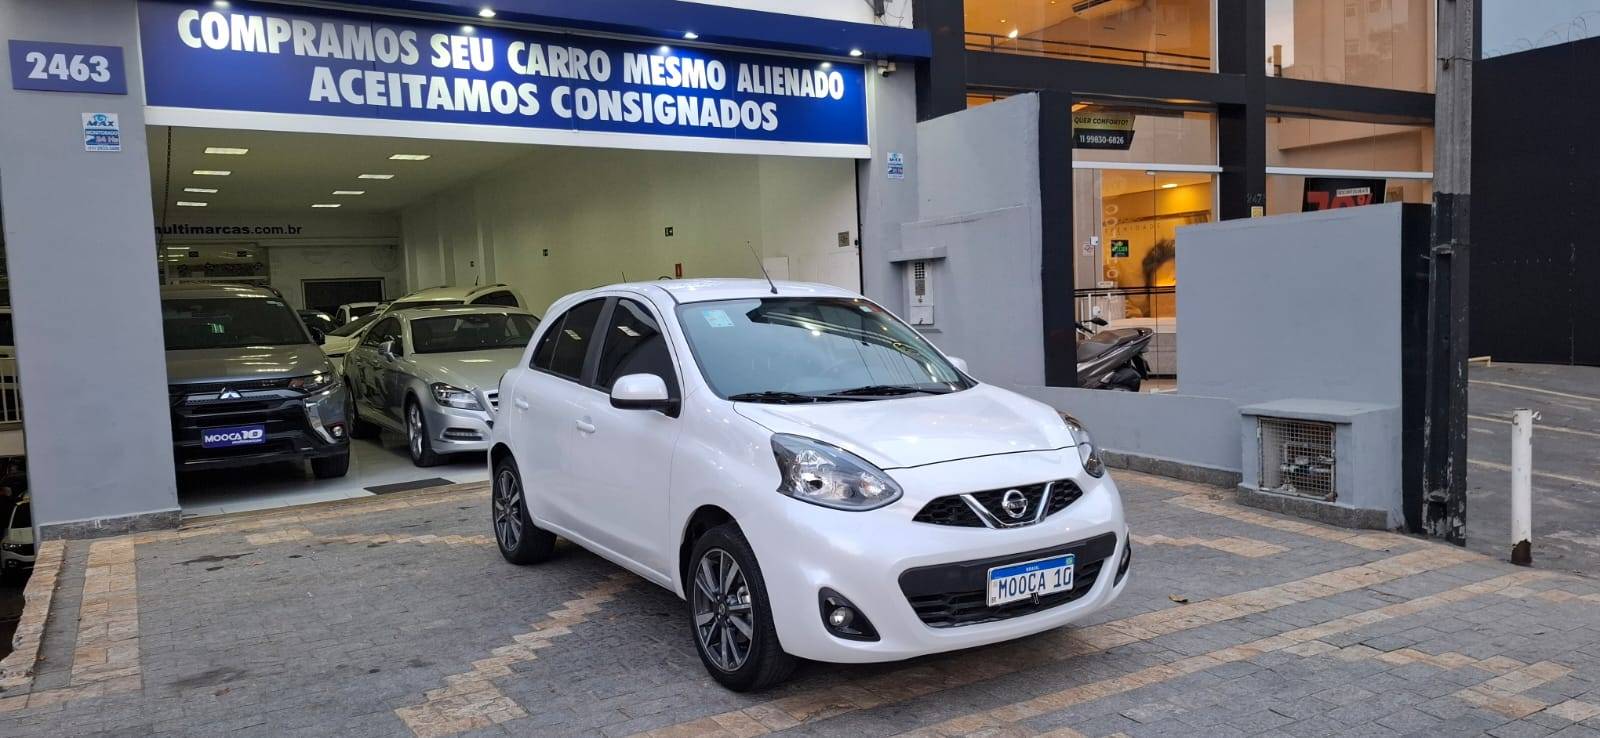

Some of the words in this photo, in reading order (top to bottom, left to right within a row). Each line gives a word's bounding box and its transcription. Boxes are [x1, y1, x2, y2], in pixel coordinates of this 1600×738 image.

[25, 52, 111, 83] 2463
[177, 9, 420, 66] COMPRAMOS
[430, 33, 494, 72] SEU
[507, 41, 611, 82] CARRO
[623, 53, 727, 91] MESMO
[737, 63, 845, 100] ALIENADO
[308, 66, 540, 116] ACEITAMOS
[551, 86, 778, 132] CONSIGNADOS
[1092, 118, 1129, 126] CONFORTO?
[1086, 135, 1125, 145] 99830-6826
[999, 571, 1046, 600] MOOCA
